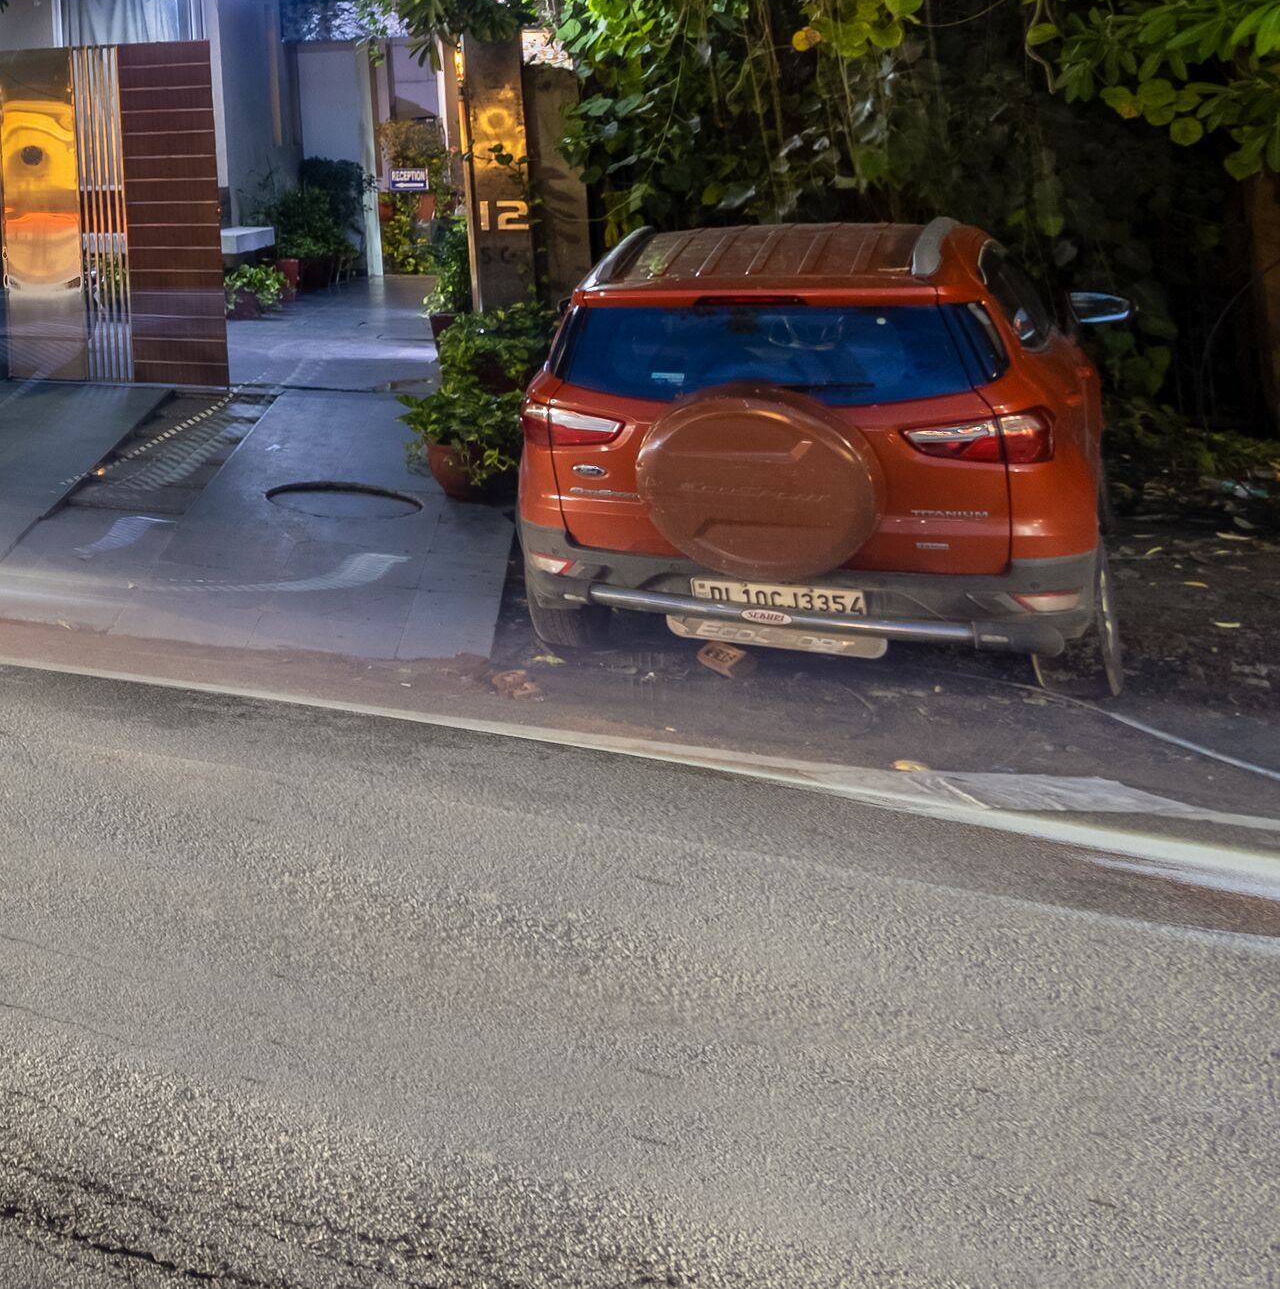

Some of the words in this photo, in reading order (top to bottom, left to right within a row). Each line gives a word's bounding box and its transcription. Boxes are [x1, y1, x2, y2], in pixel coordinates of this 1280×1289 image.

[391, 170, 426, 181] RECEPTION
[479, 200, 529, 231] 12
[911, 510, 989, 518] TITANIUM
